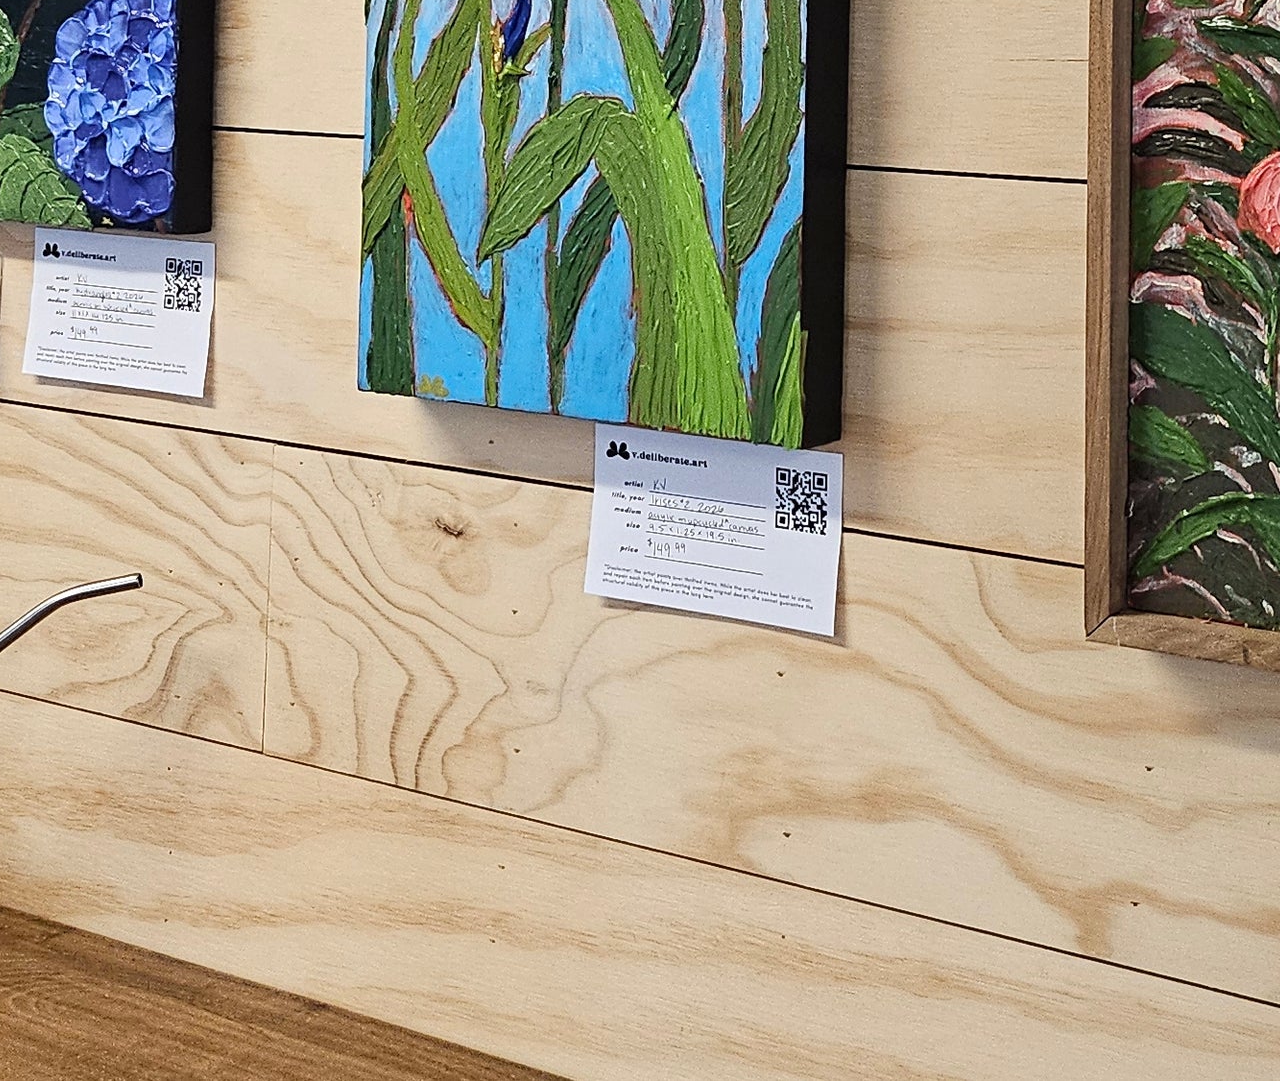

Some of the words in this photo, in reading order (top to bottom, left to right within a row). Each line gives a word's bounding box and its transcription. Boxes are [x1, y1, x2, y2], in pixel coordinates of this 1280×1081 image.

[632, 451, 707, 468] v.deliberate.art
[653, 478, 666, 490] KV
[651, 494, 678, 508] Irises
[697, 502, 724, 514] 2026
